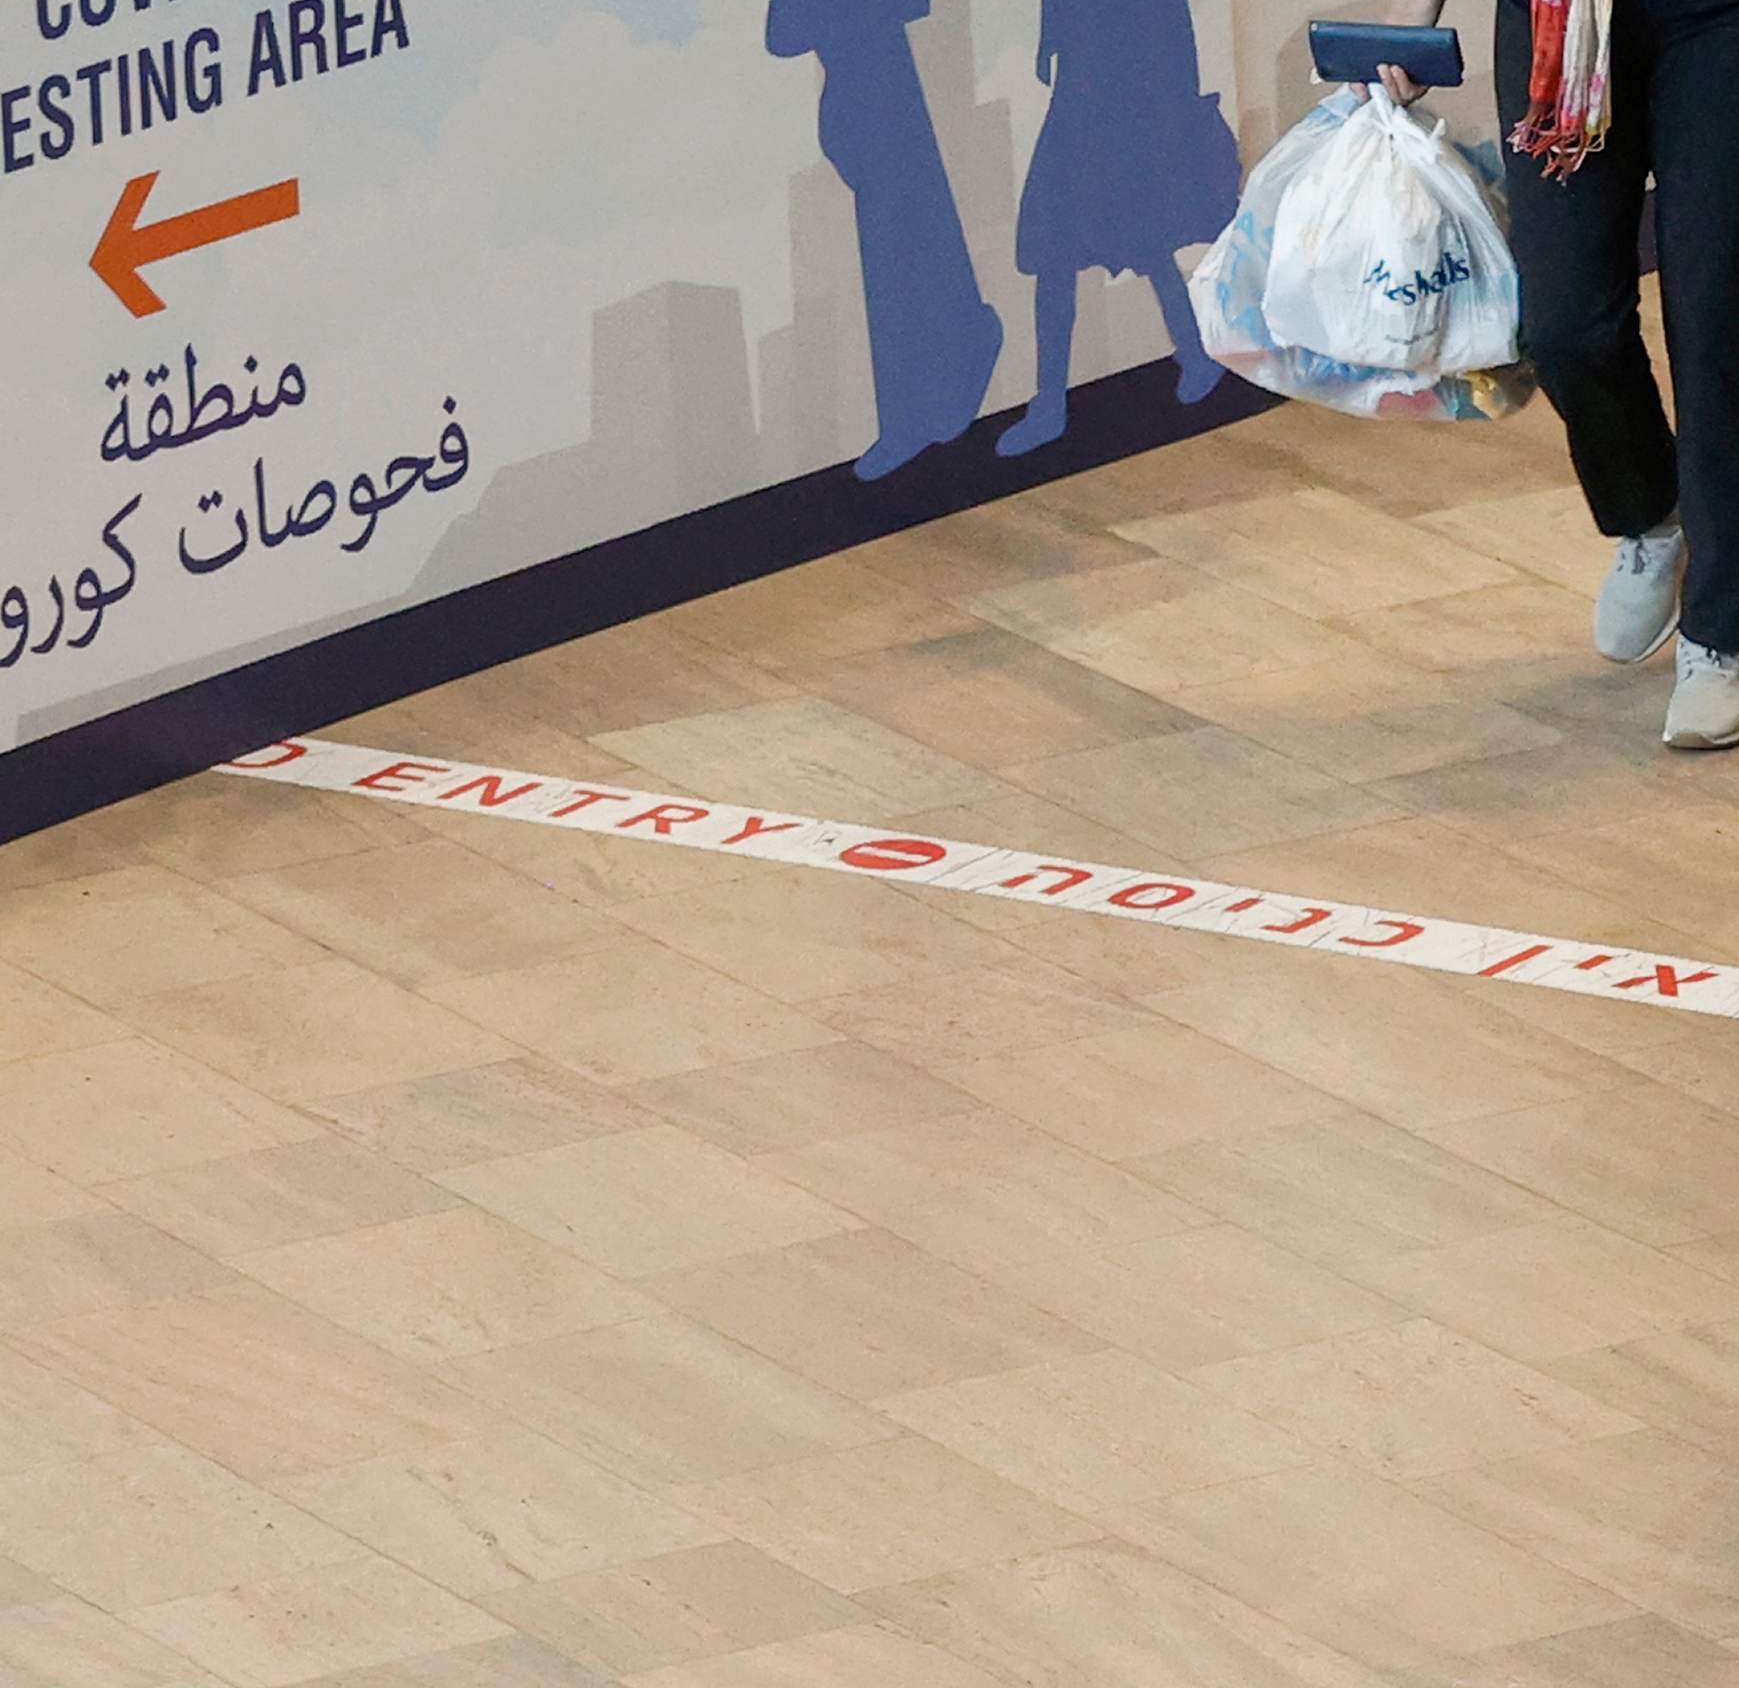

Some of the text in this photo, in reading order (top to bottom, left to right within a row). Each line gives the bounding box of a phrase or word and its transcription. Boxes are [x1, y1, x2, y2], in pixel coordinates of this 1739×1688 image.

[0, 25, 224, 175] ESTING
[98, 344, 308, 464] منطقة
[177, 397, 470, 576] فحوصات
[352, 761, 803, 845] ENTRY
[999, 863, 1719, 997] אין כניסה
